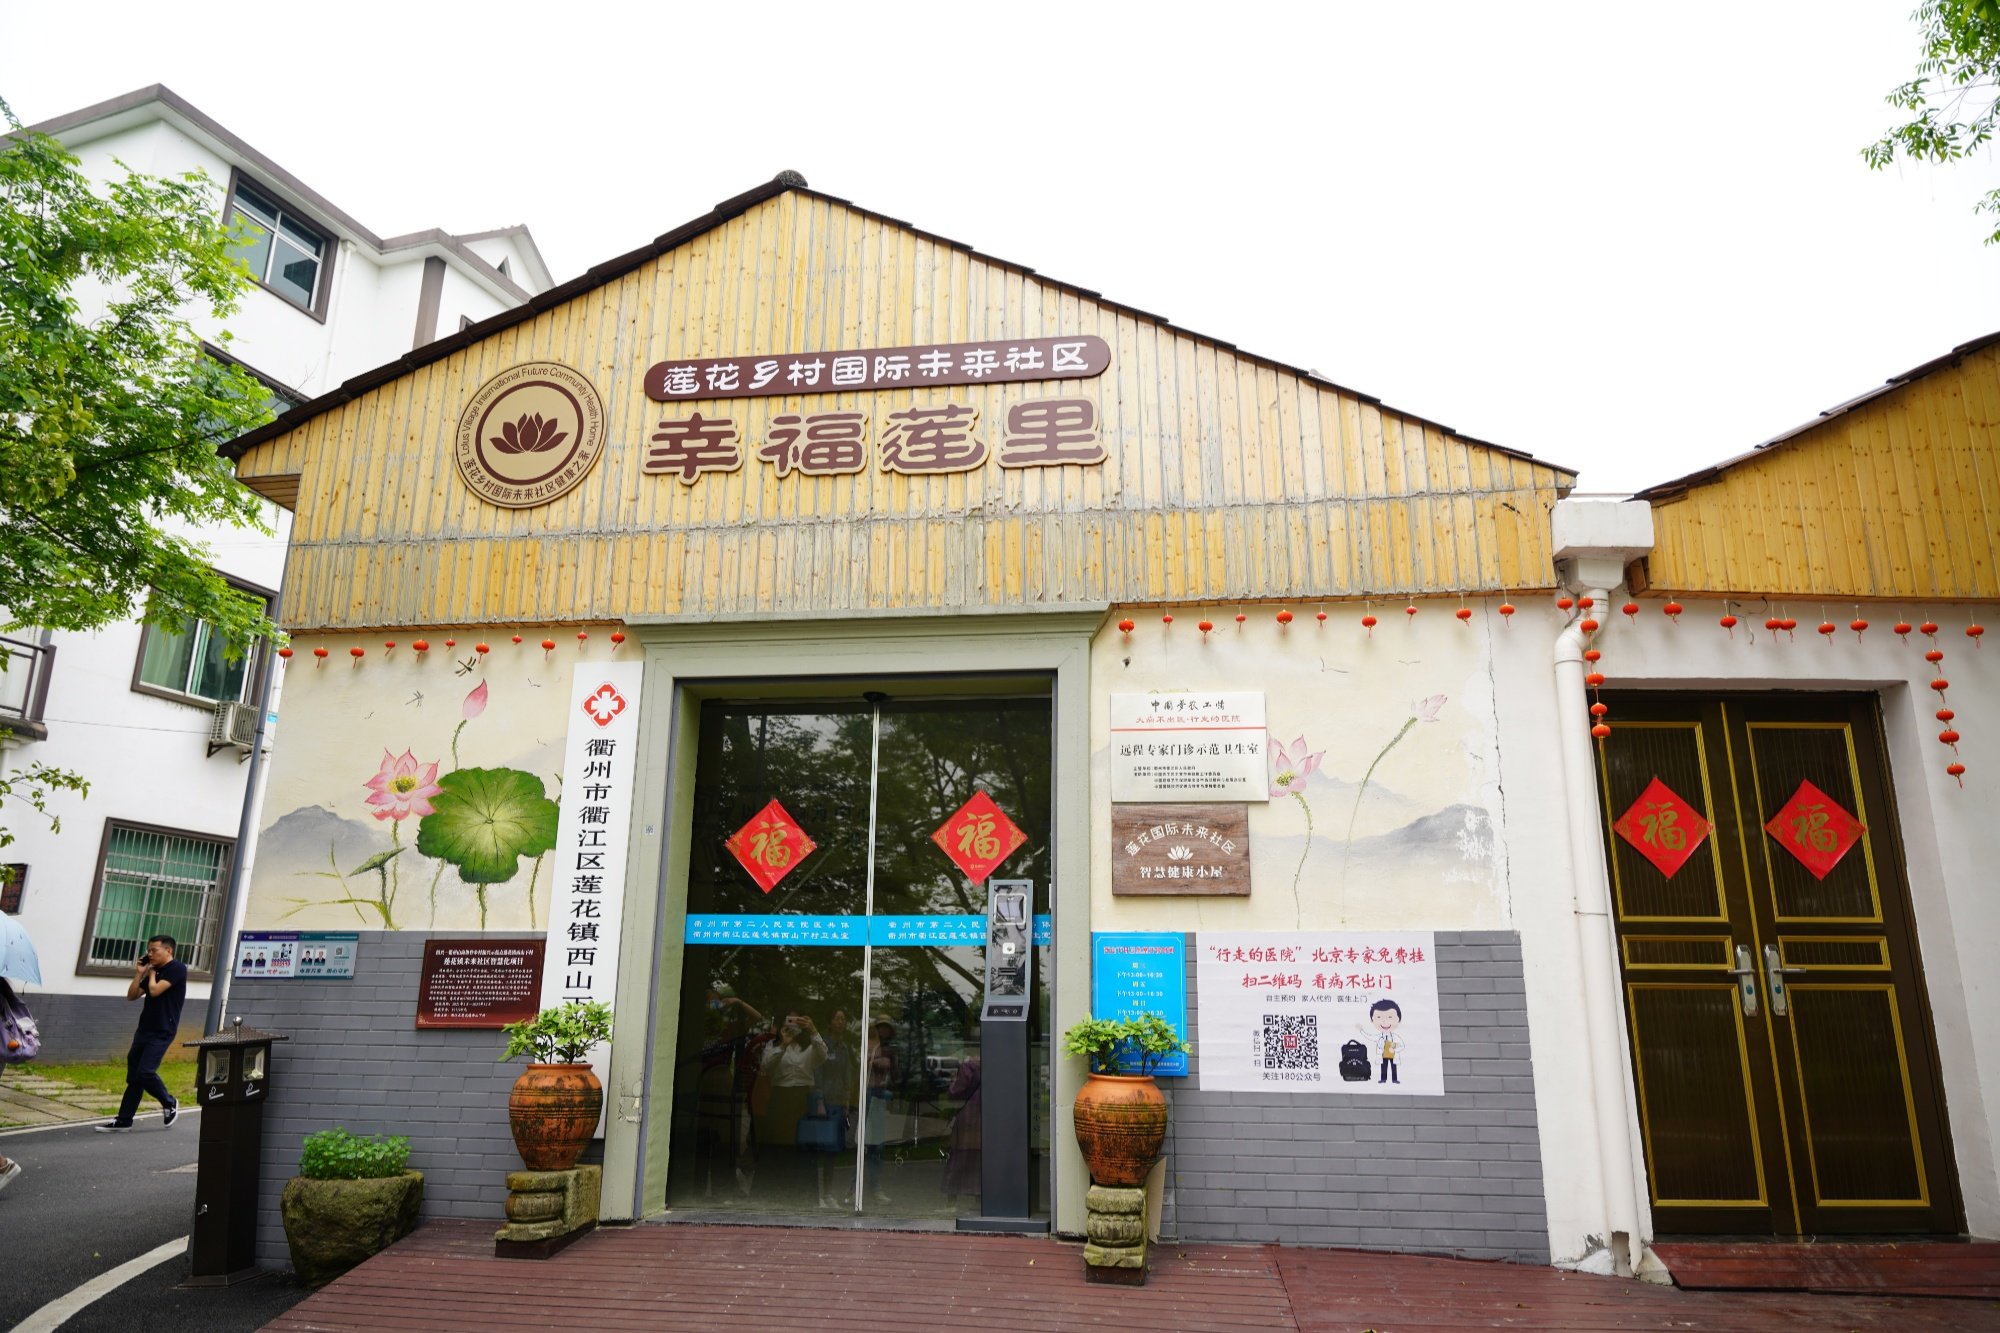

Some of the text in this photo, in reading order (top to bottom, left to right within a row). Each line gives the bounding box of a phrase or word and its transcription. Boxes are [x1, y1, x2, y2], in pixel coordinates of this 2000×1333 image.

[663, 342, 1089, 395] 莲花乡村国际未来社区
[461, 367, 600, 457] Lotus Village International Future Community Health Home
[645, 397, 1104, 483] 幸福莲里
[463, 449, 591, 500] 莲花乡村国际未来社区健康之家
[1120, 743, 1259, 757] 远程专家门诊示范卫生室
[750, 821, 792, 868] 福
[957, 812, 1000, 859] 福
[1125, 822, 1237, 857] 莲花国际未来社区
[1639, 802, 1687, 850] 福
[1791, 803, 1838, 853] 福
[1139, 865, 1224, 879] 智慧健康小屋
[1311, 946, 1426, 964] 北京专家免费挂
[1241, 972, 1393, 990] 扫二维码 看病不出门
[1266, 994, 1368, 1003] 自主预约 家人代约 医生上门
[1262, 1072, 1321, 1081] 关注180公众号
